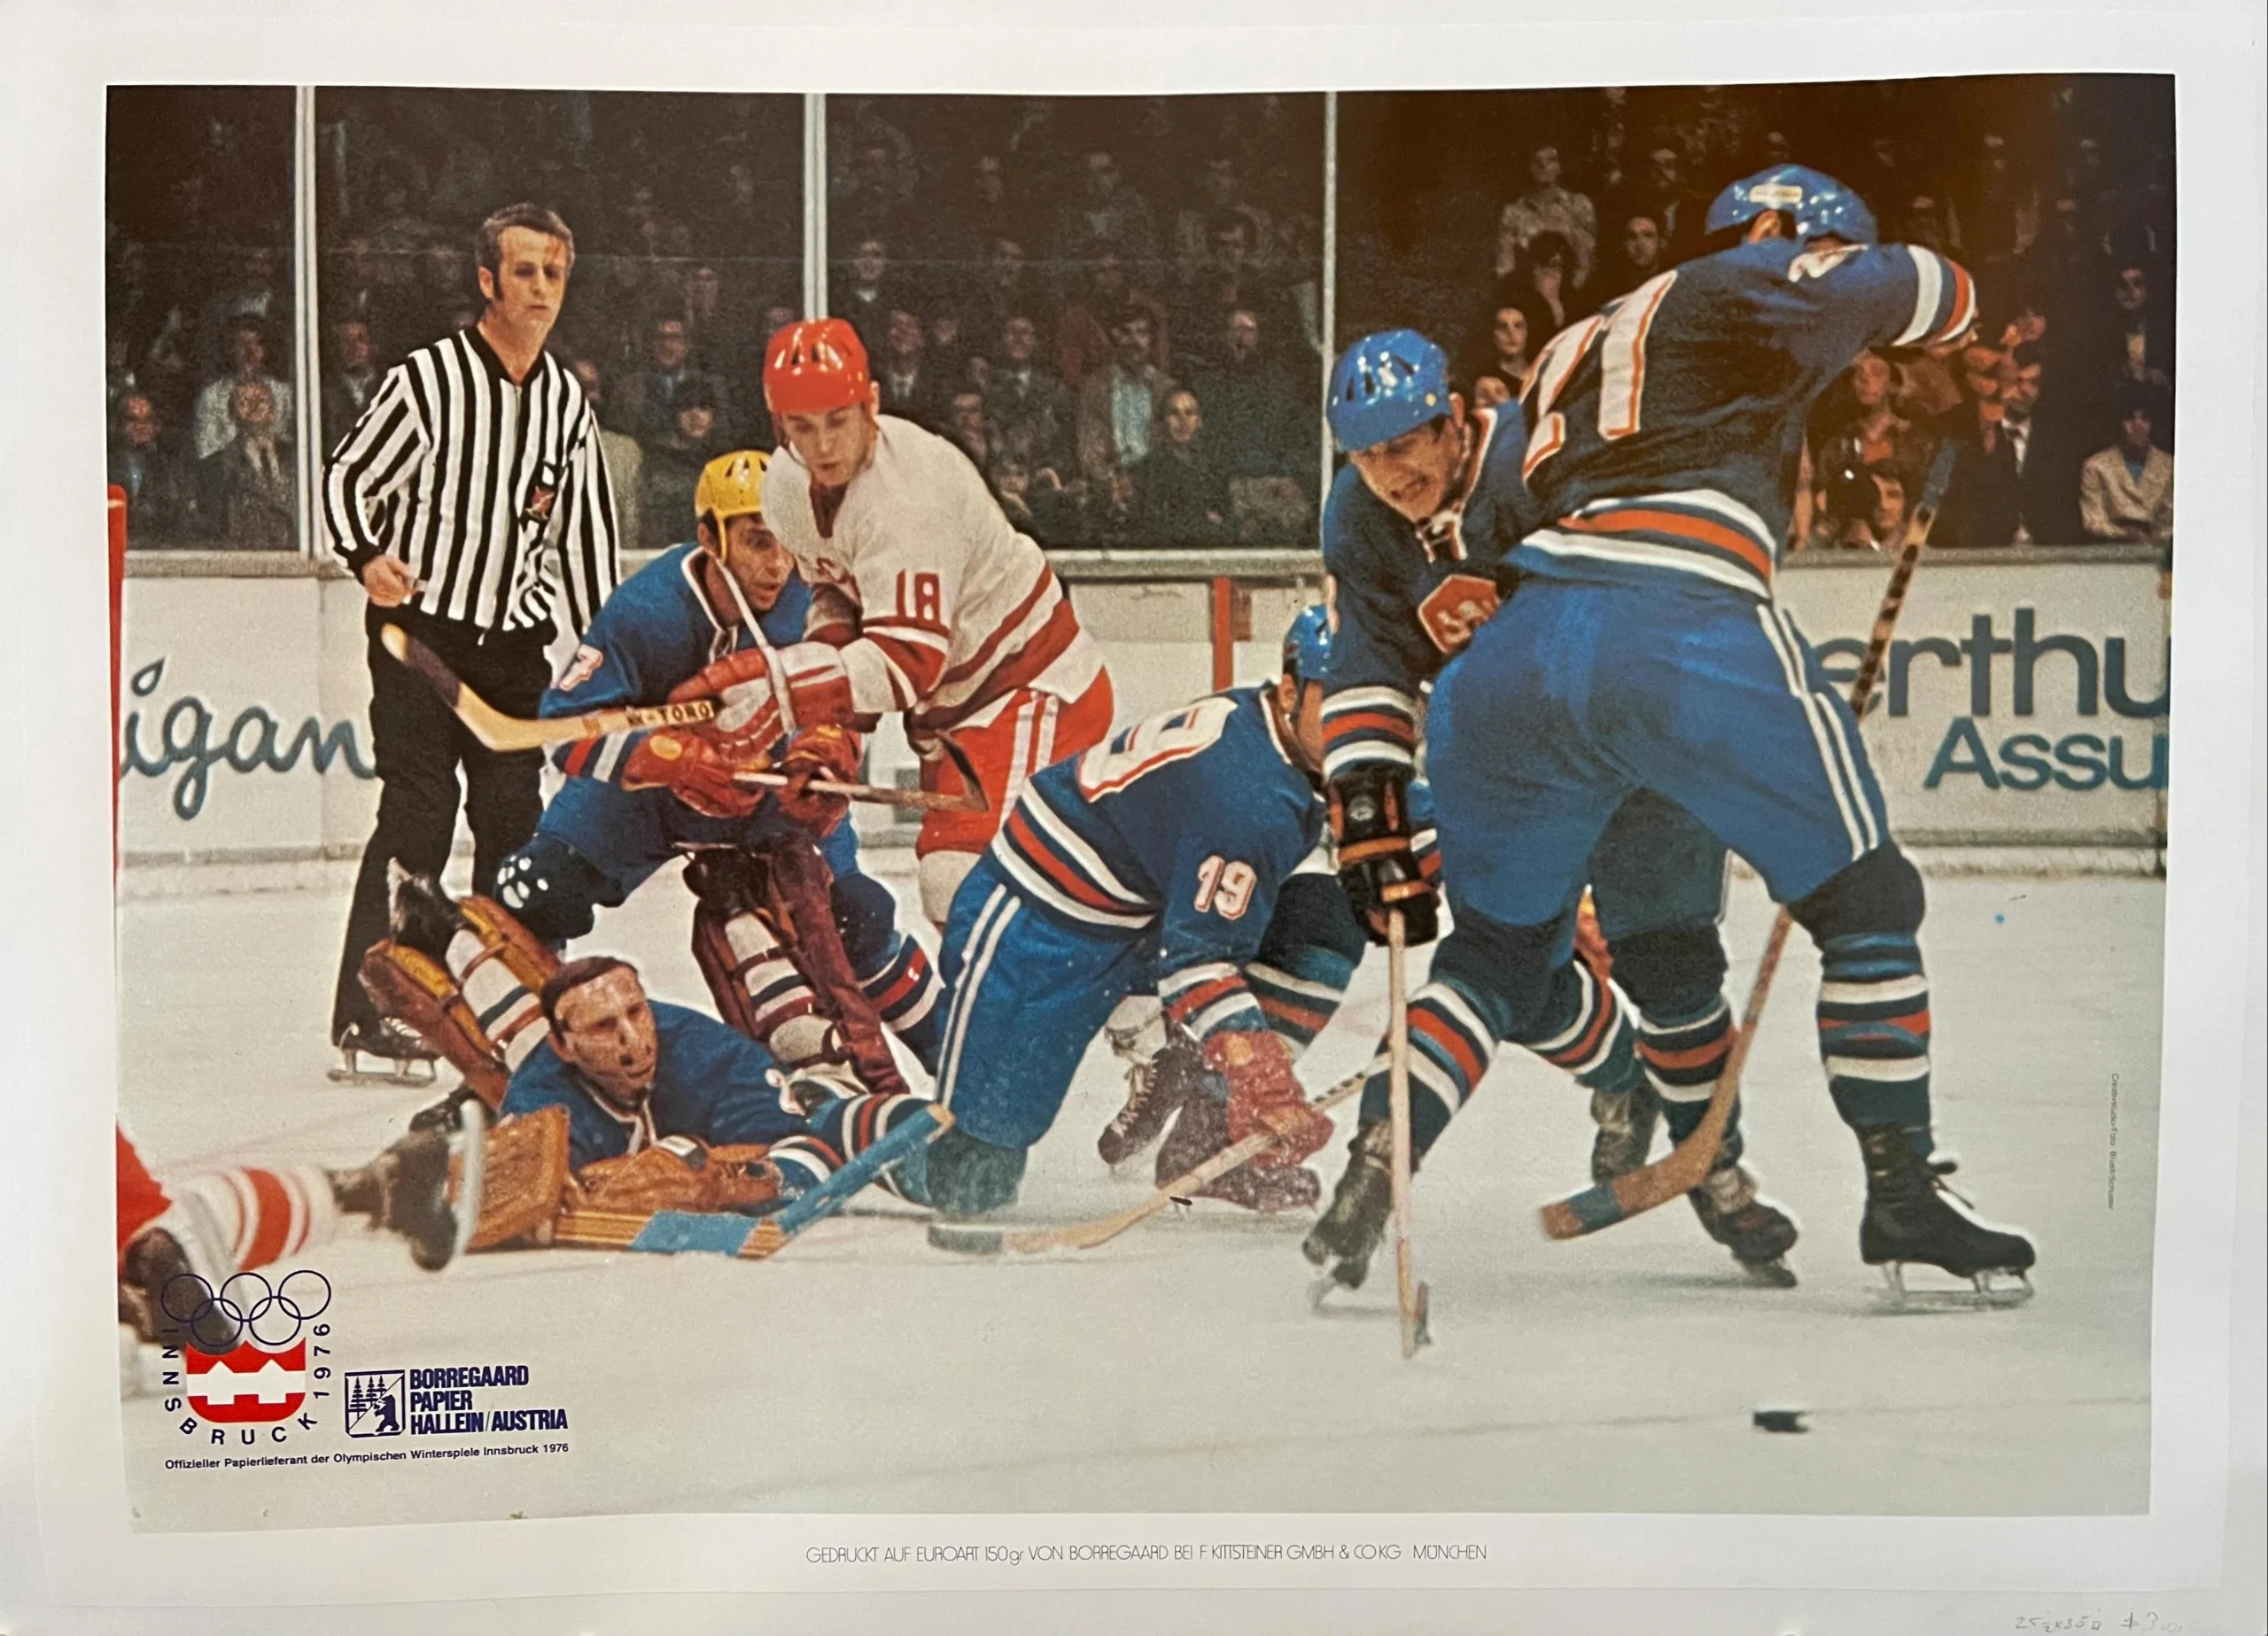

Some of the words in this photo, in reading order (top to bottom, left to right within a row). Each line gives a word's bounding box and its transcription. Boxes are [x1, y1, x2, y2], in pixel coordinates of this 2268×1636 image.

[896, 569, 941, 624] 18
[121, 656, 376, 821] igan
[1923, 716, 2169, 791] Assu
[1194, 855, 1257, 920] 19
[162, 1329, 318, 1446] INNSBRUCK
[313, 1323, 331, 1399] 1976
[409, 1365, 529, 1390] BORREGAARD
[410, 1390, 472, 1412] PAPIER
[411, 1408, 568, 1435] HALLEIN/AUSTRIA
[165, 1459, 220, 1469] Offizieller
[224, 1456, 307, 1469] Papierlieferant
[311, 1454, 330, 1463] der
[333, 1449, 407, 1465] Olympischen
[410, 1446, 479, 1459] Winterspiele
[484, 1444, 539, 1455] Innsbruck
[543, 1443, 569, 1453] 1976
[806, 1547, 879, 1562] GEDRUCKT
[884, 1547, 912, 1562] AUF
[916, 1546, 980, 1562] EUROART
[1029, 1545, 1063, 1561] VON
[1069, 1545, 1169, 1560] BORREGAARD
[1174, 1545, 1192, 1559] BEI
[1212, 1544, 1283, 1559] KITTSTEINER
[1286, 1544, 1334, 1559] GMBH
[1339, 1544, 1349, 1559] &
[1413, 1544, 1487, 1559] MÜNCHEN
